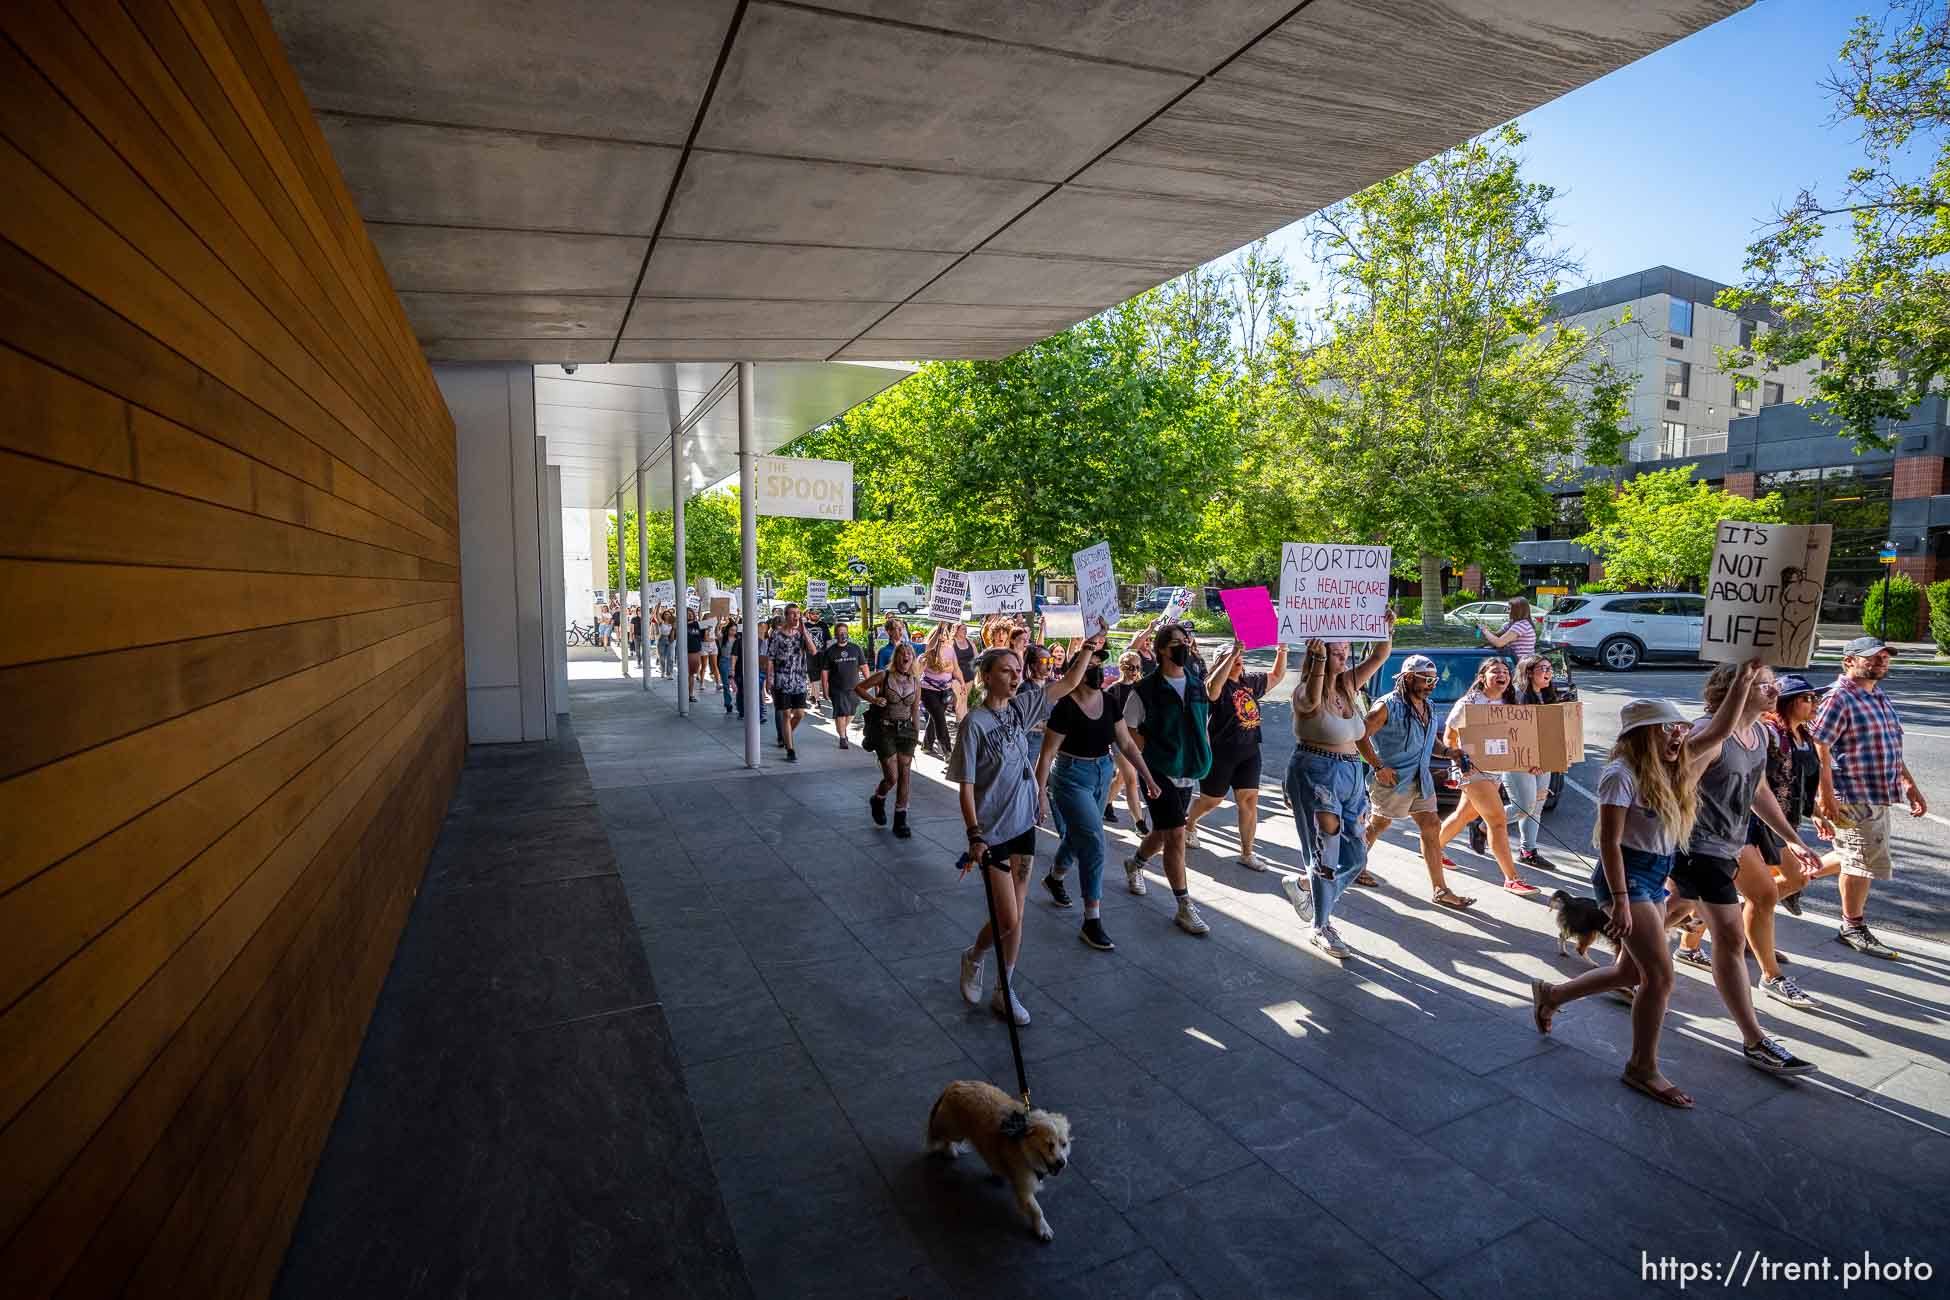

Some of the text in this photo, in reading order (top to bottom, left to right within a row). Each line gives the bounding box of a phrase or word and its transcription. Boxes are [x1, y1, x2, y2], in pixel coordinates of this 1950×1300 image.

[768, 462, 788, 473] THE
[768, 475, 844, 502] SPOON
[1721, 525, 1768, 545] IT'S
[1283, 546, 1388, 572] ABORTION
[1718, 553, 1768, 578] NOT
[939, 577, 965, 588] SYSTEM
[948, 571, 960, 580] THE
[1014, 573, 1026, 582] MY
[984, 583, 1021, 595] CHOICE
[1294, 577, 1387, 597] IS HEALTHCARE
[1710, 581, 1779, 604] ABOUT
[934, 595, 962, 607] FIGHT FOR
[1286, 595, 1368, 610] HEALTHCARE IS
[1280, 613, 1387, 635] A HUMAN RIGHT
[1707, 614, 1778, 647] LIFE
[1490, 706, 1504, 719] MY
